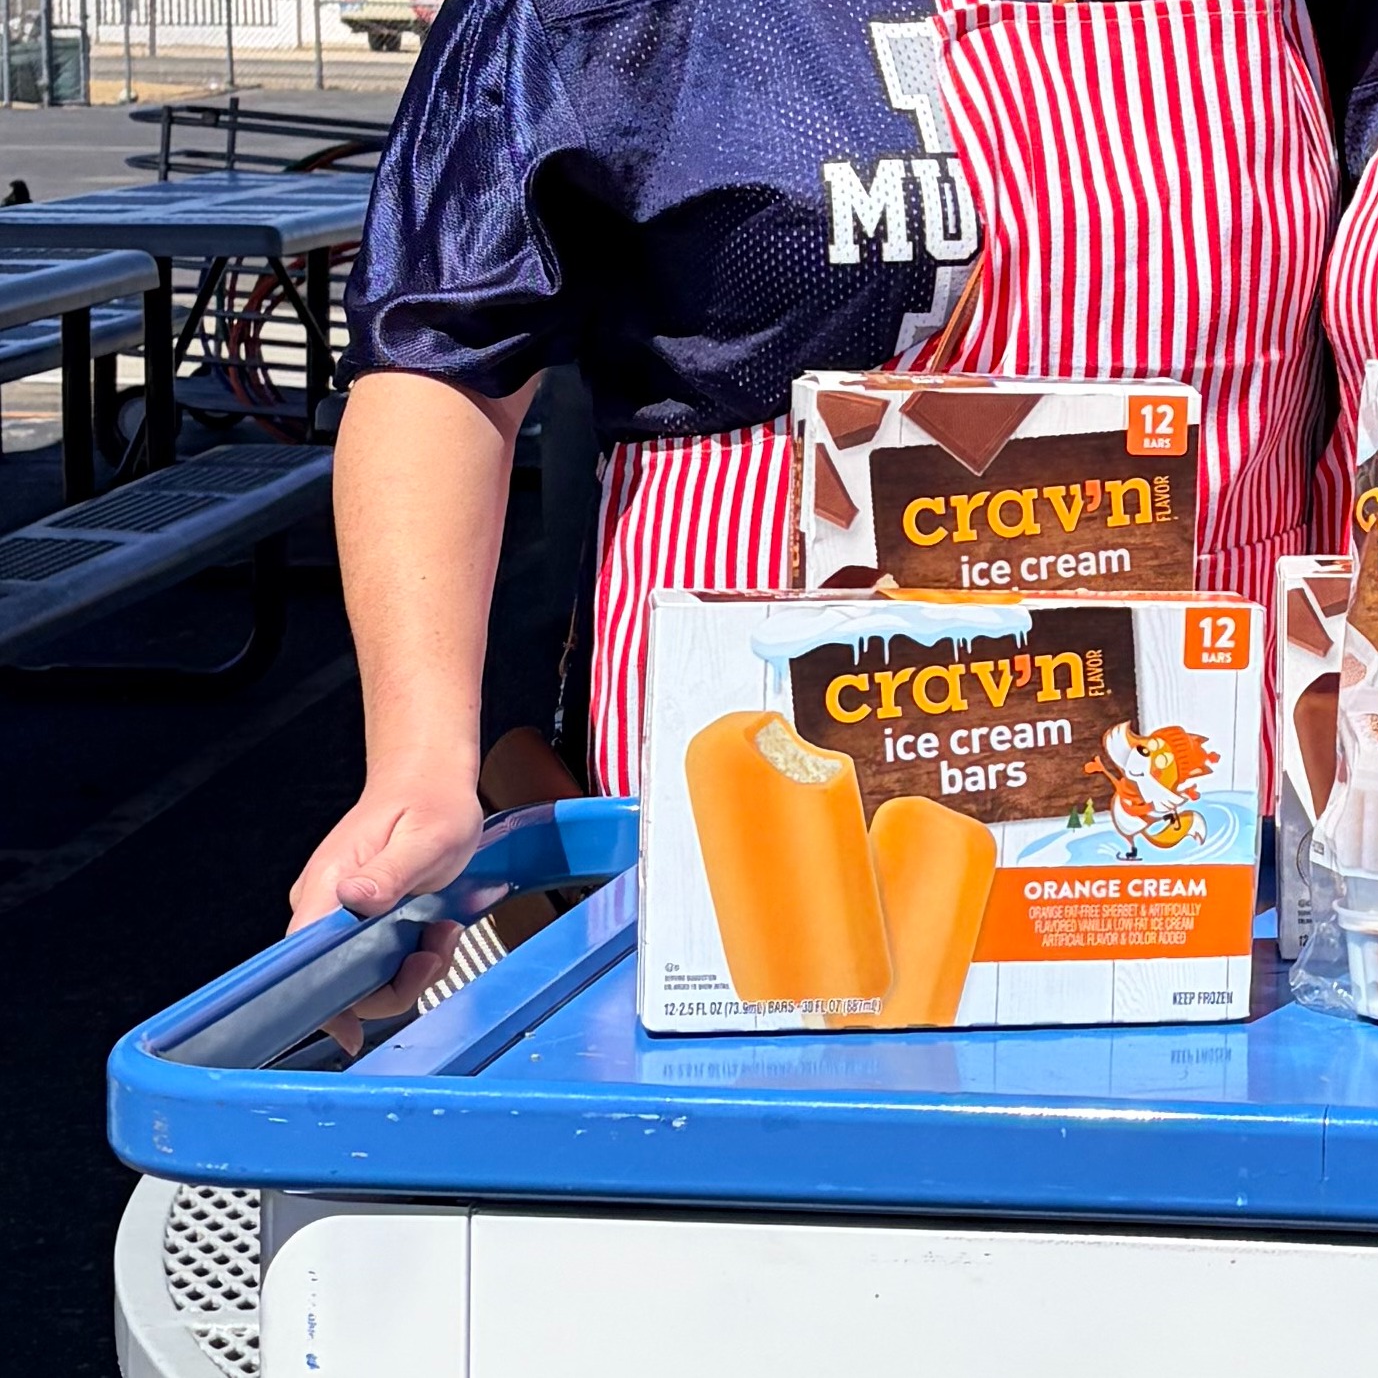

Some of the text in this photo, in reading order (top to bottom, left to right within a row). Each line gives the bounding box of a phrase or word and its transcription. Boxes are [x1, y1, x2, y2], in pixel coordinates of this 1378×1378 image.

[1141, 405, 1174, 435] 12
[1143, 438, 1171, 449] BARS
[903, 477, 1154, 546] crav'n
[1155, 475, 1171, 522] FLAVOR
[961, 549, 1131, 588] ice cream
[1199, 616, 1236, 648] 12
[1086, 649, 1104, 697] FLAVOR
[1201, 652, 1232, 664] BARS
[825, 651, 1085, 723] crav'n
[884, 719, 1072, 763] ice cream
[940, 761, 1027, 795] bars
[1024, 878, 1207, 900] ORANGE CREAM
[696, 1002, 707, 1015] FL
[710, 1002, 722, 1015] OZ
[767, 1000, 794, 1014] BARS
[801, 999, 813, 1013] 30
[815, 999, 827, 1012] FL
[1172, 991, 1233, 1005] KEEP FROZEN
